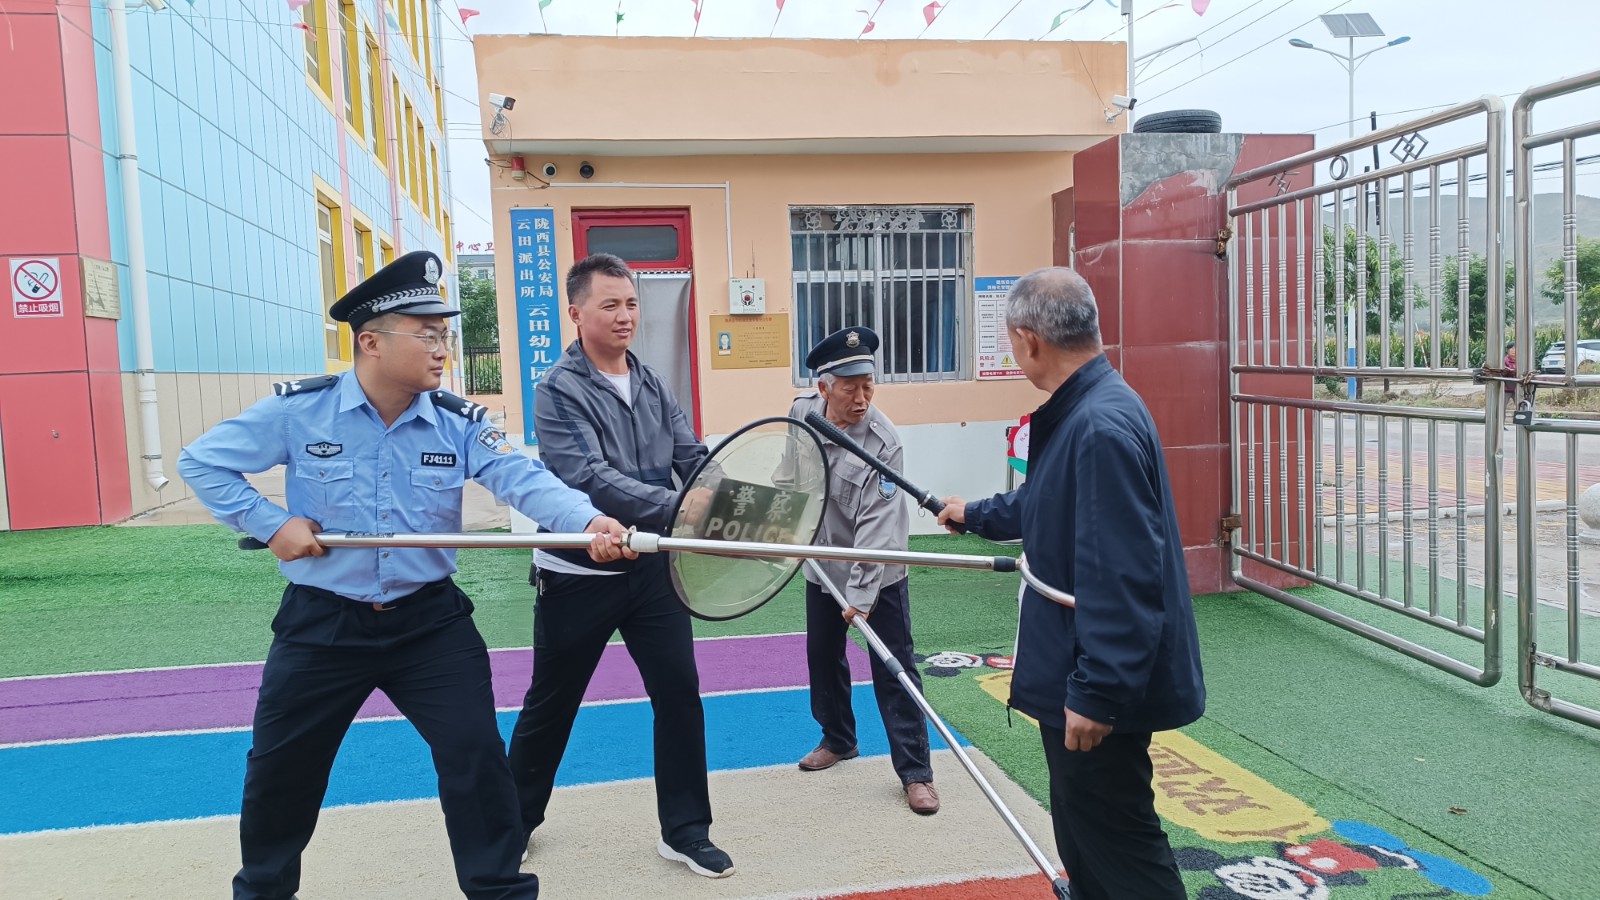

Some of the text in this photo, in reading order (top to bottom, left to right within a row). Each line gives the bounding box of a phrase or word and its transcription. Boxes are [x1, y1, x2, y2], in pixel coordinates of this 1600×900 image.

[515, 218, 535, 298] 云田派出所
[534, 217, 554, 298] 陇西县公安局
[18, 303, 59, 314] 禁止吸烟
[526, 303, 553, 390] 云田幼儿园
[423, 455, 454, 465] FJ4111
[732, 485, 793, 522] 警察
[704, 517, 797, 545] POLICE
